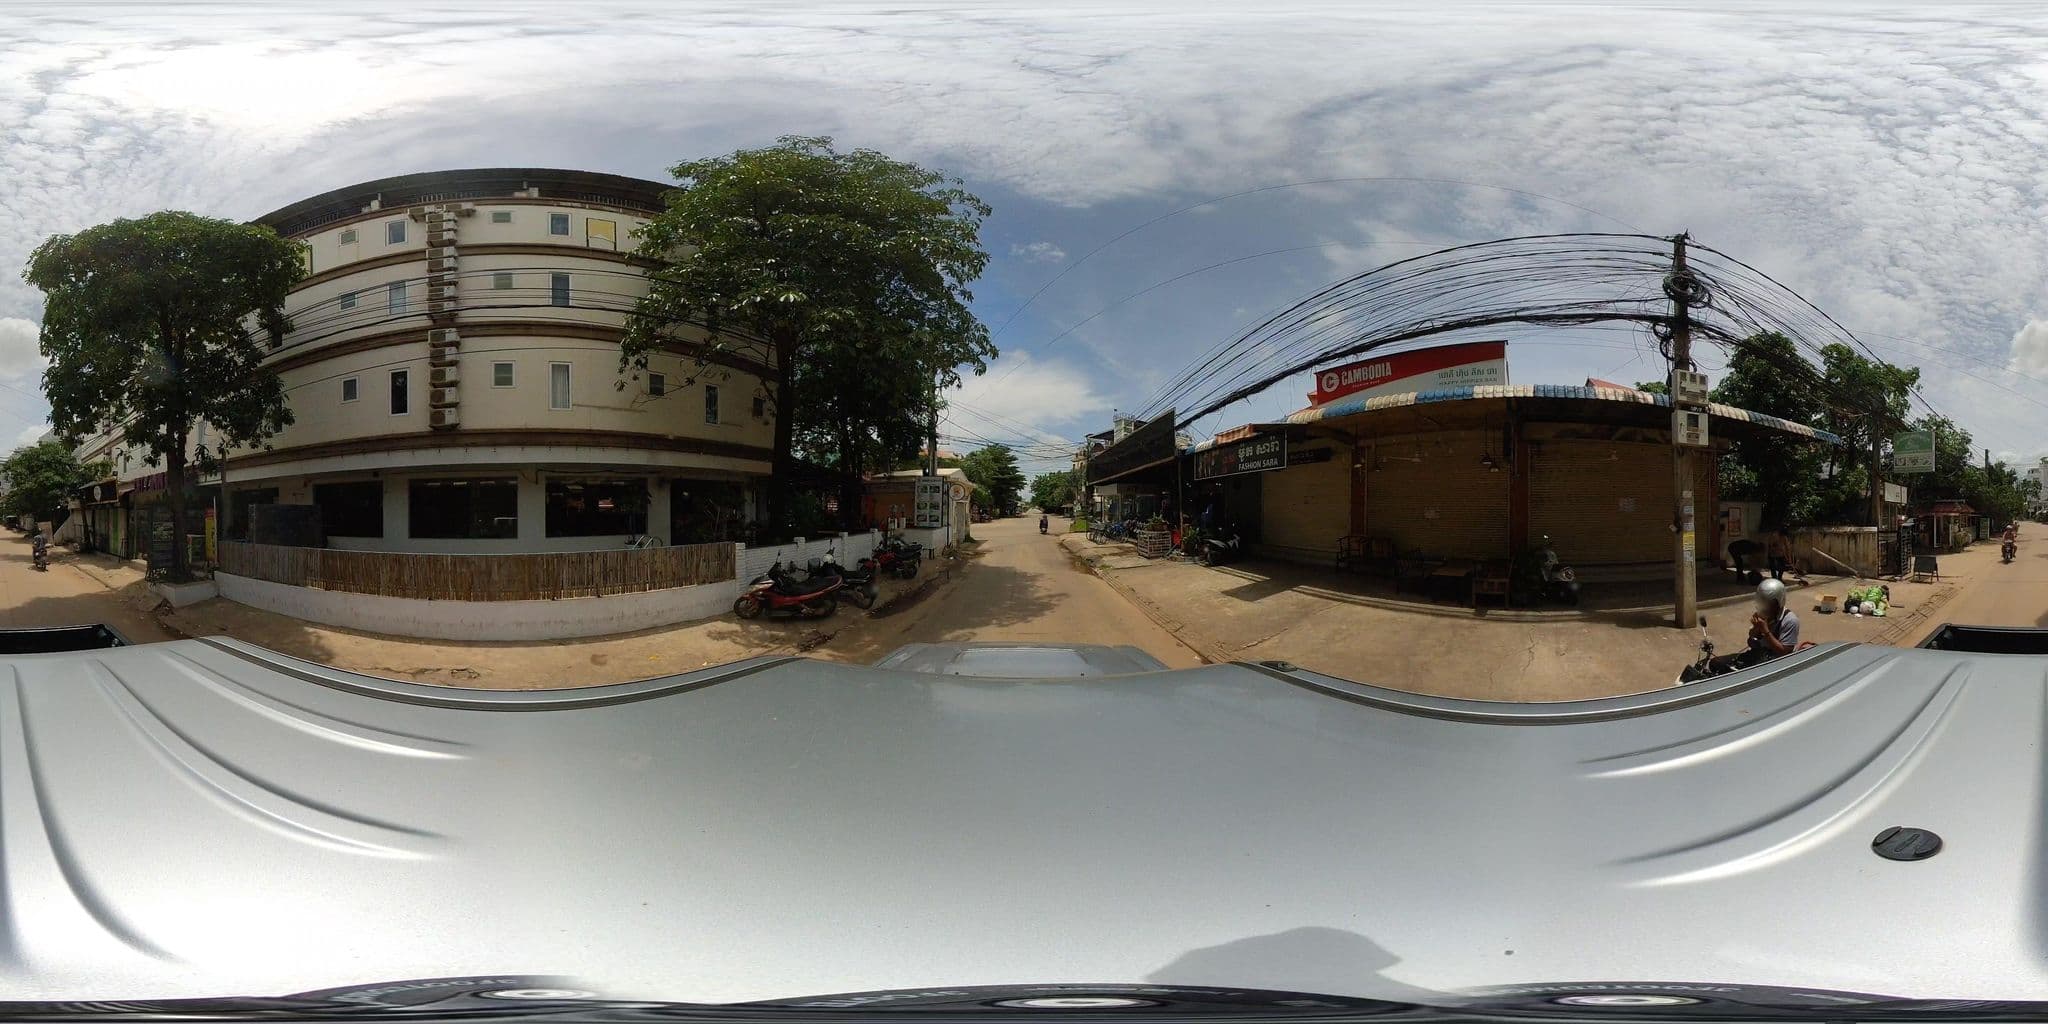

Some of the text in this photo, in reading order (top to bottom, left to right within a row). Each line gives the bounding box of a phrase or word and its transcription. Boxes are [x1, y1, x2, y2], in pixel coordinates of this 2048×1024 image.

[1341, 362, 1392, 386] CAMBODIA
[1238, 457, 1279, 471] FASHION SARA
